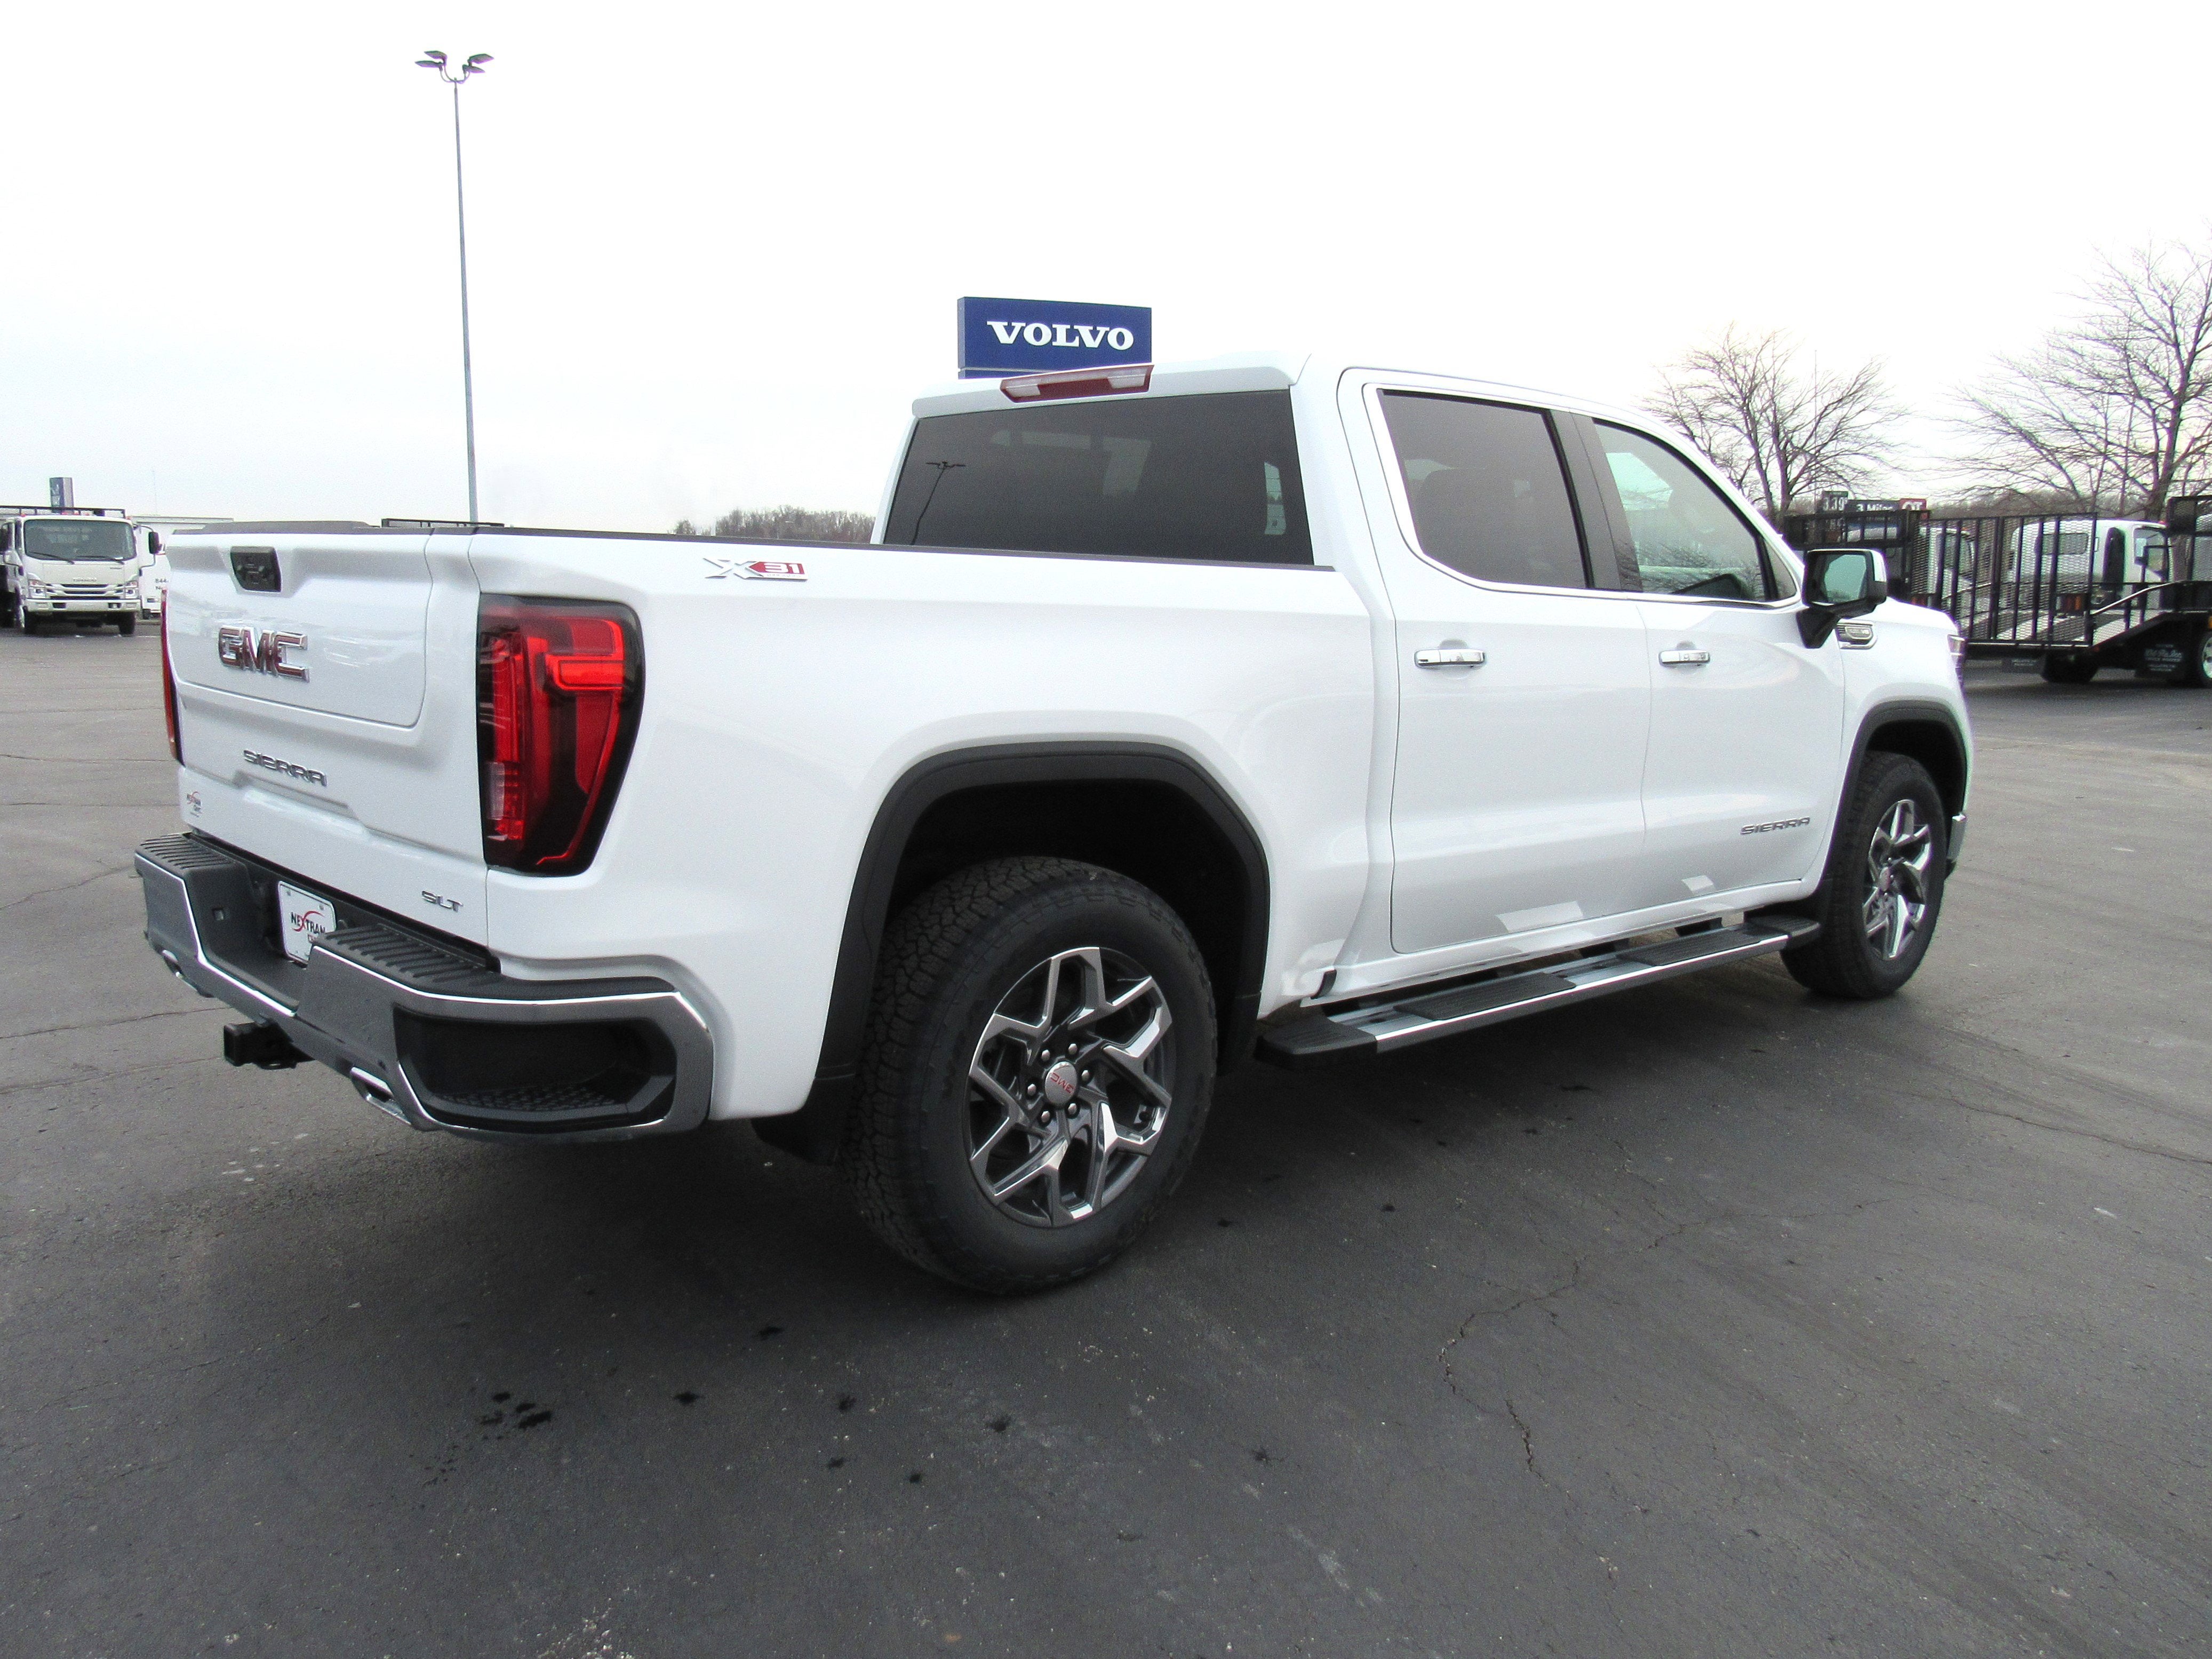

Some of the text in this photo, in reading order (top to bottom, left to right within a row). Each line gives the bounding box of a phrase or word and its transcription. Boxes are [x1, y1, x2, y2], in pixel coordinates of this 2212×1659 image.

[986, 321, 1135, 350] VOLVO
[218, 625, 310, 683] GMC
[243, 748, 328, 787] SIERRA
[1740, 816, 1810, 835] SIERRA
[421, 890, 464, 912] SLT
[291, 911, 325, 934] NEXTRAN
[1050, 1072, 1075, 1094] GMC
